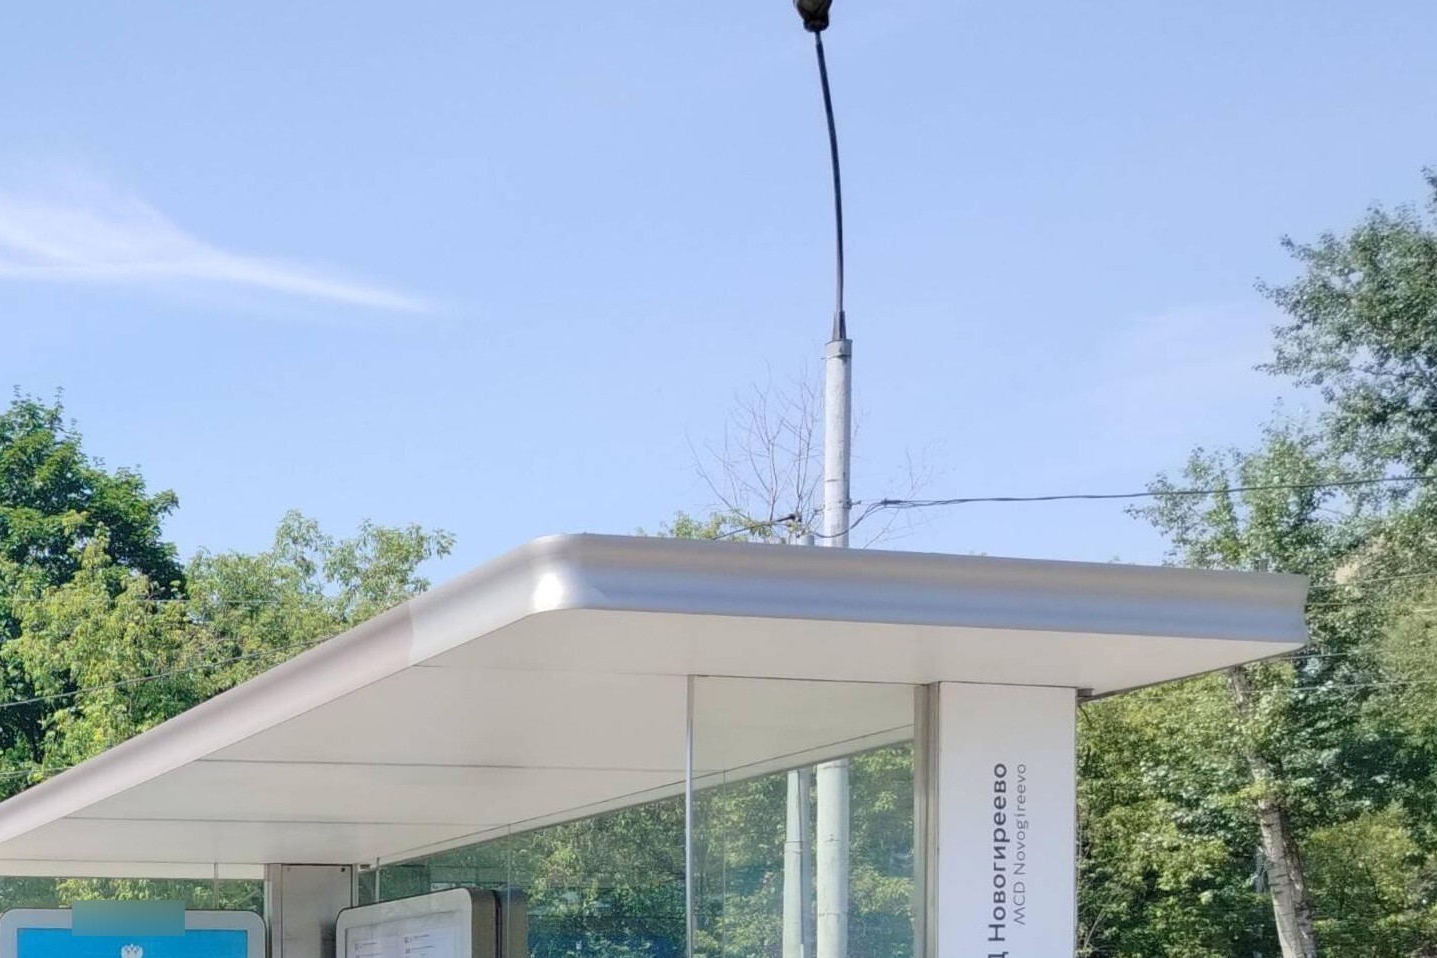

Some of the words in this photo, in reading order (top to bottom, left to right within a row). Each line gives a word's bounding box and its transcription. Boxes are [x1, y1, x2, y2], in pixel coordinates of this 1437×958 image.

[987, 763, 1010, 942] Новогиреево
[1012, 763, 1029, 876] Novogireevo
[1012, 881, 1026, 926] MCD
